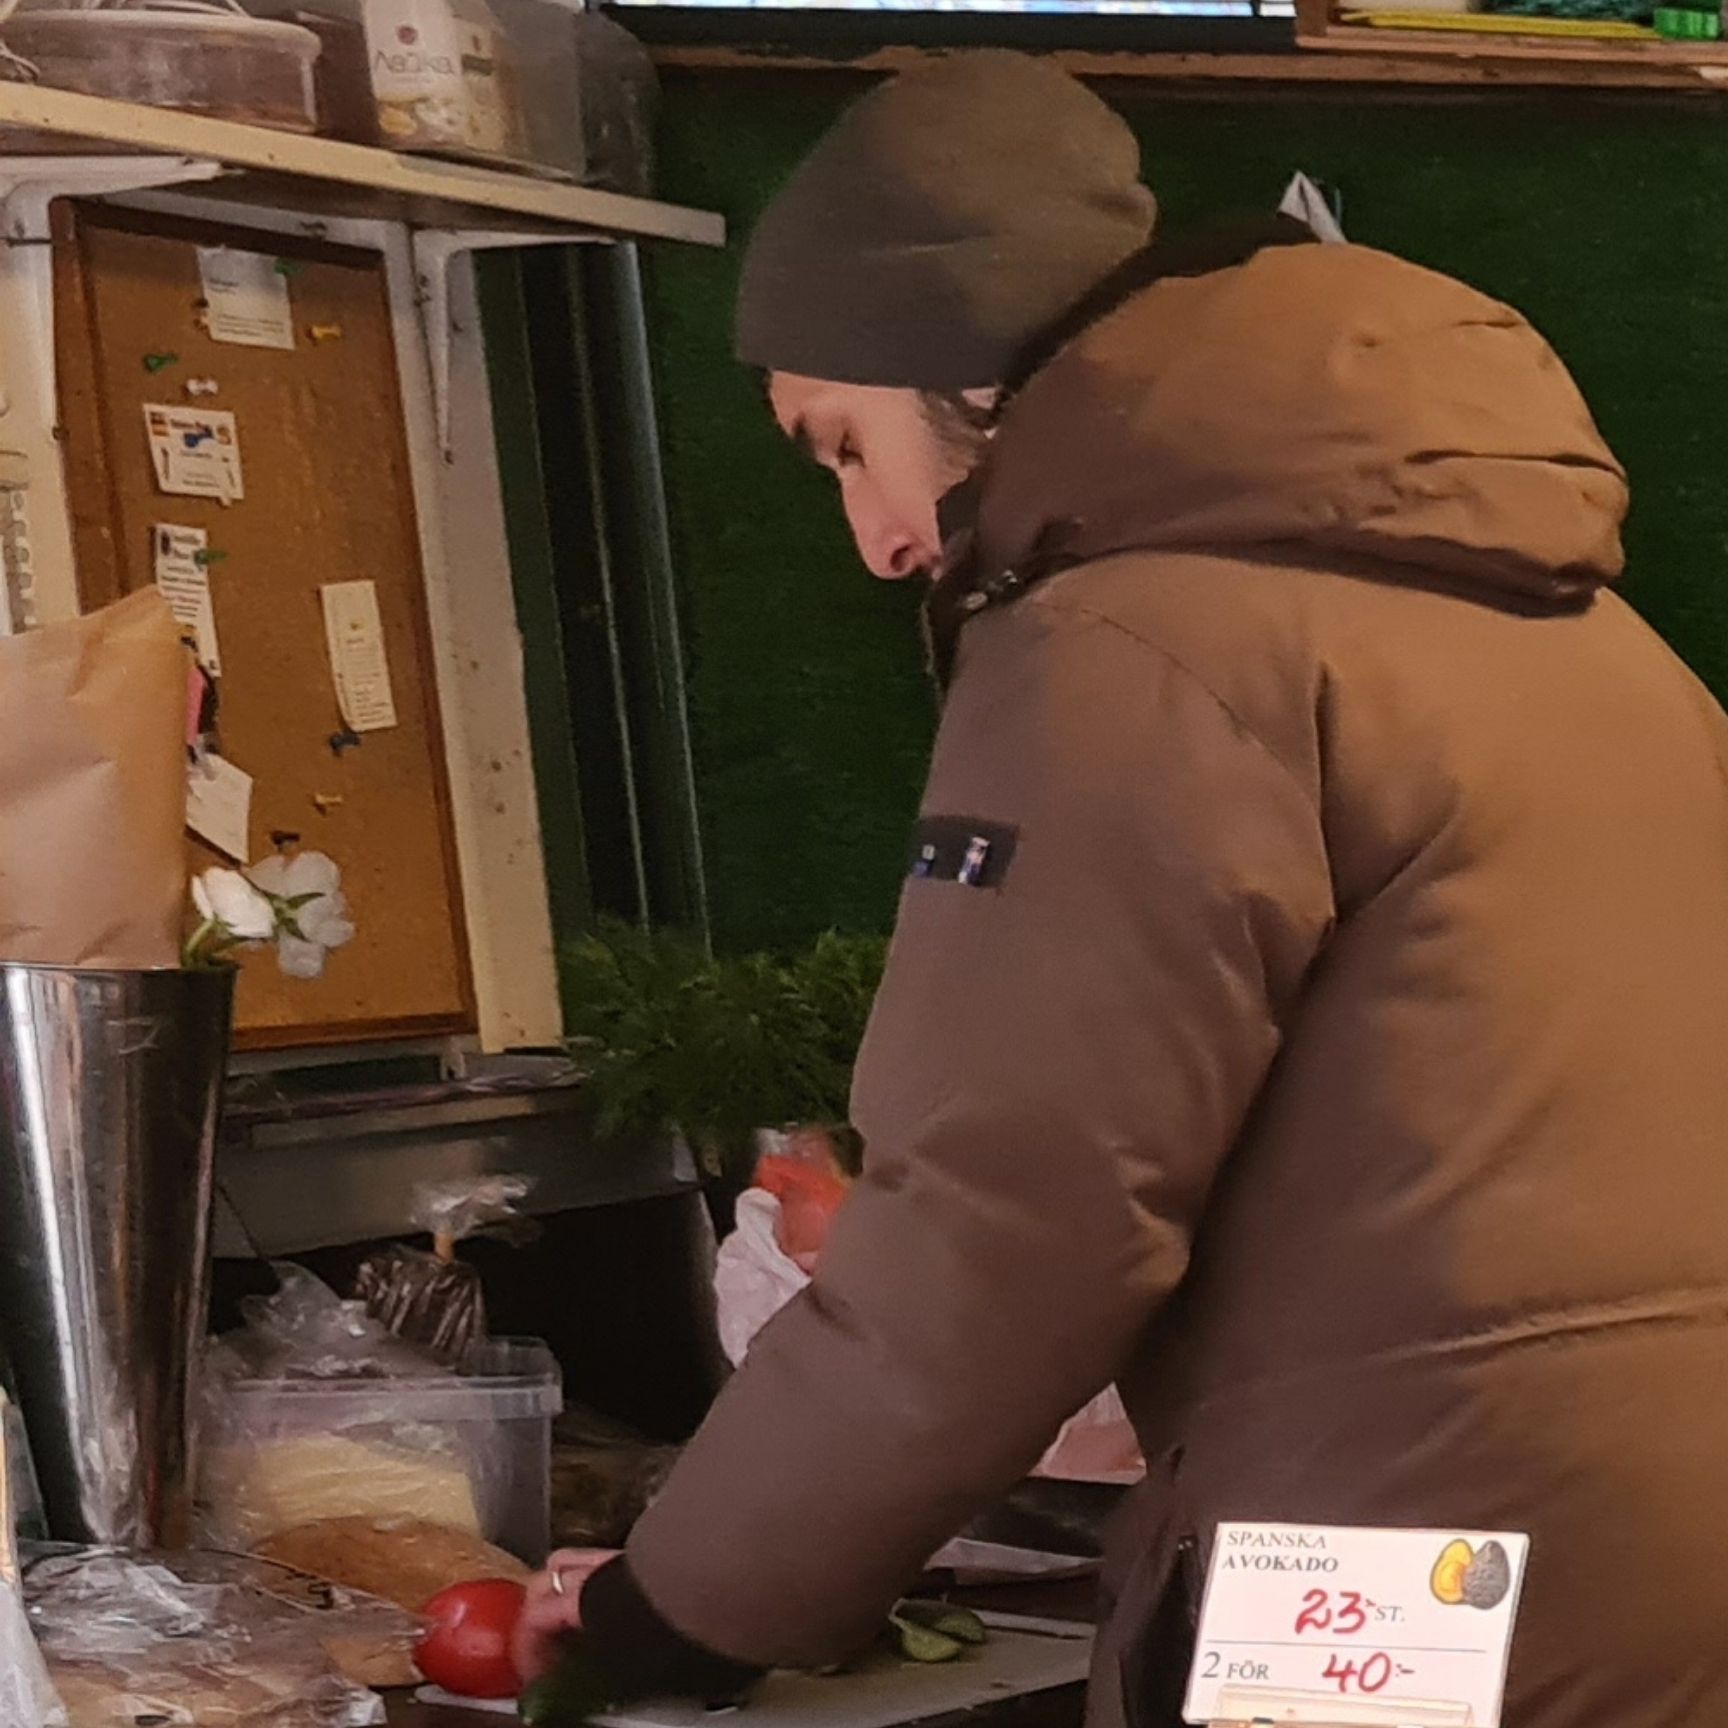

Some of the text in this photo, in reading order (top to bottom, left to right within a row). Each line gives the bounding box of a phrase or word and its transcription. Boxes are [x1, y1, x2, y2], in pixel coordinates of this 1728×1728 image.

[1226, 1530, 1327, 1549] SPANSKA
[1222, 1554, 1339, 1573] AVOKADO
[1375, 1605, 1406, 1623] ST.
[1201, 1650, 1221, 1679] 2
[1227, 1660, 1269, 1681] FÖR
